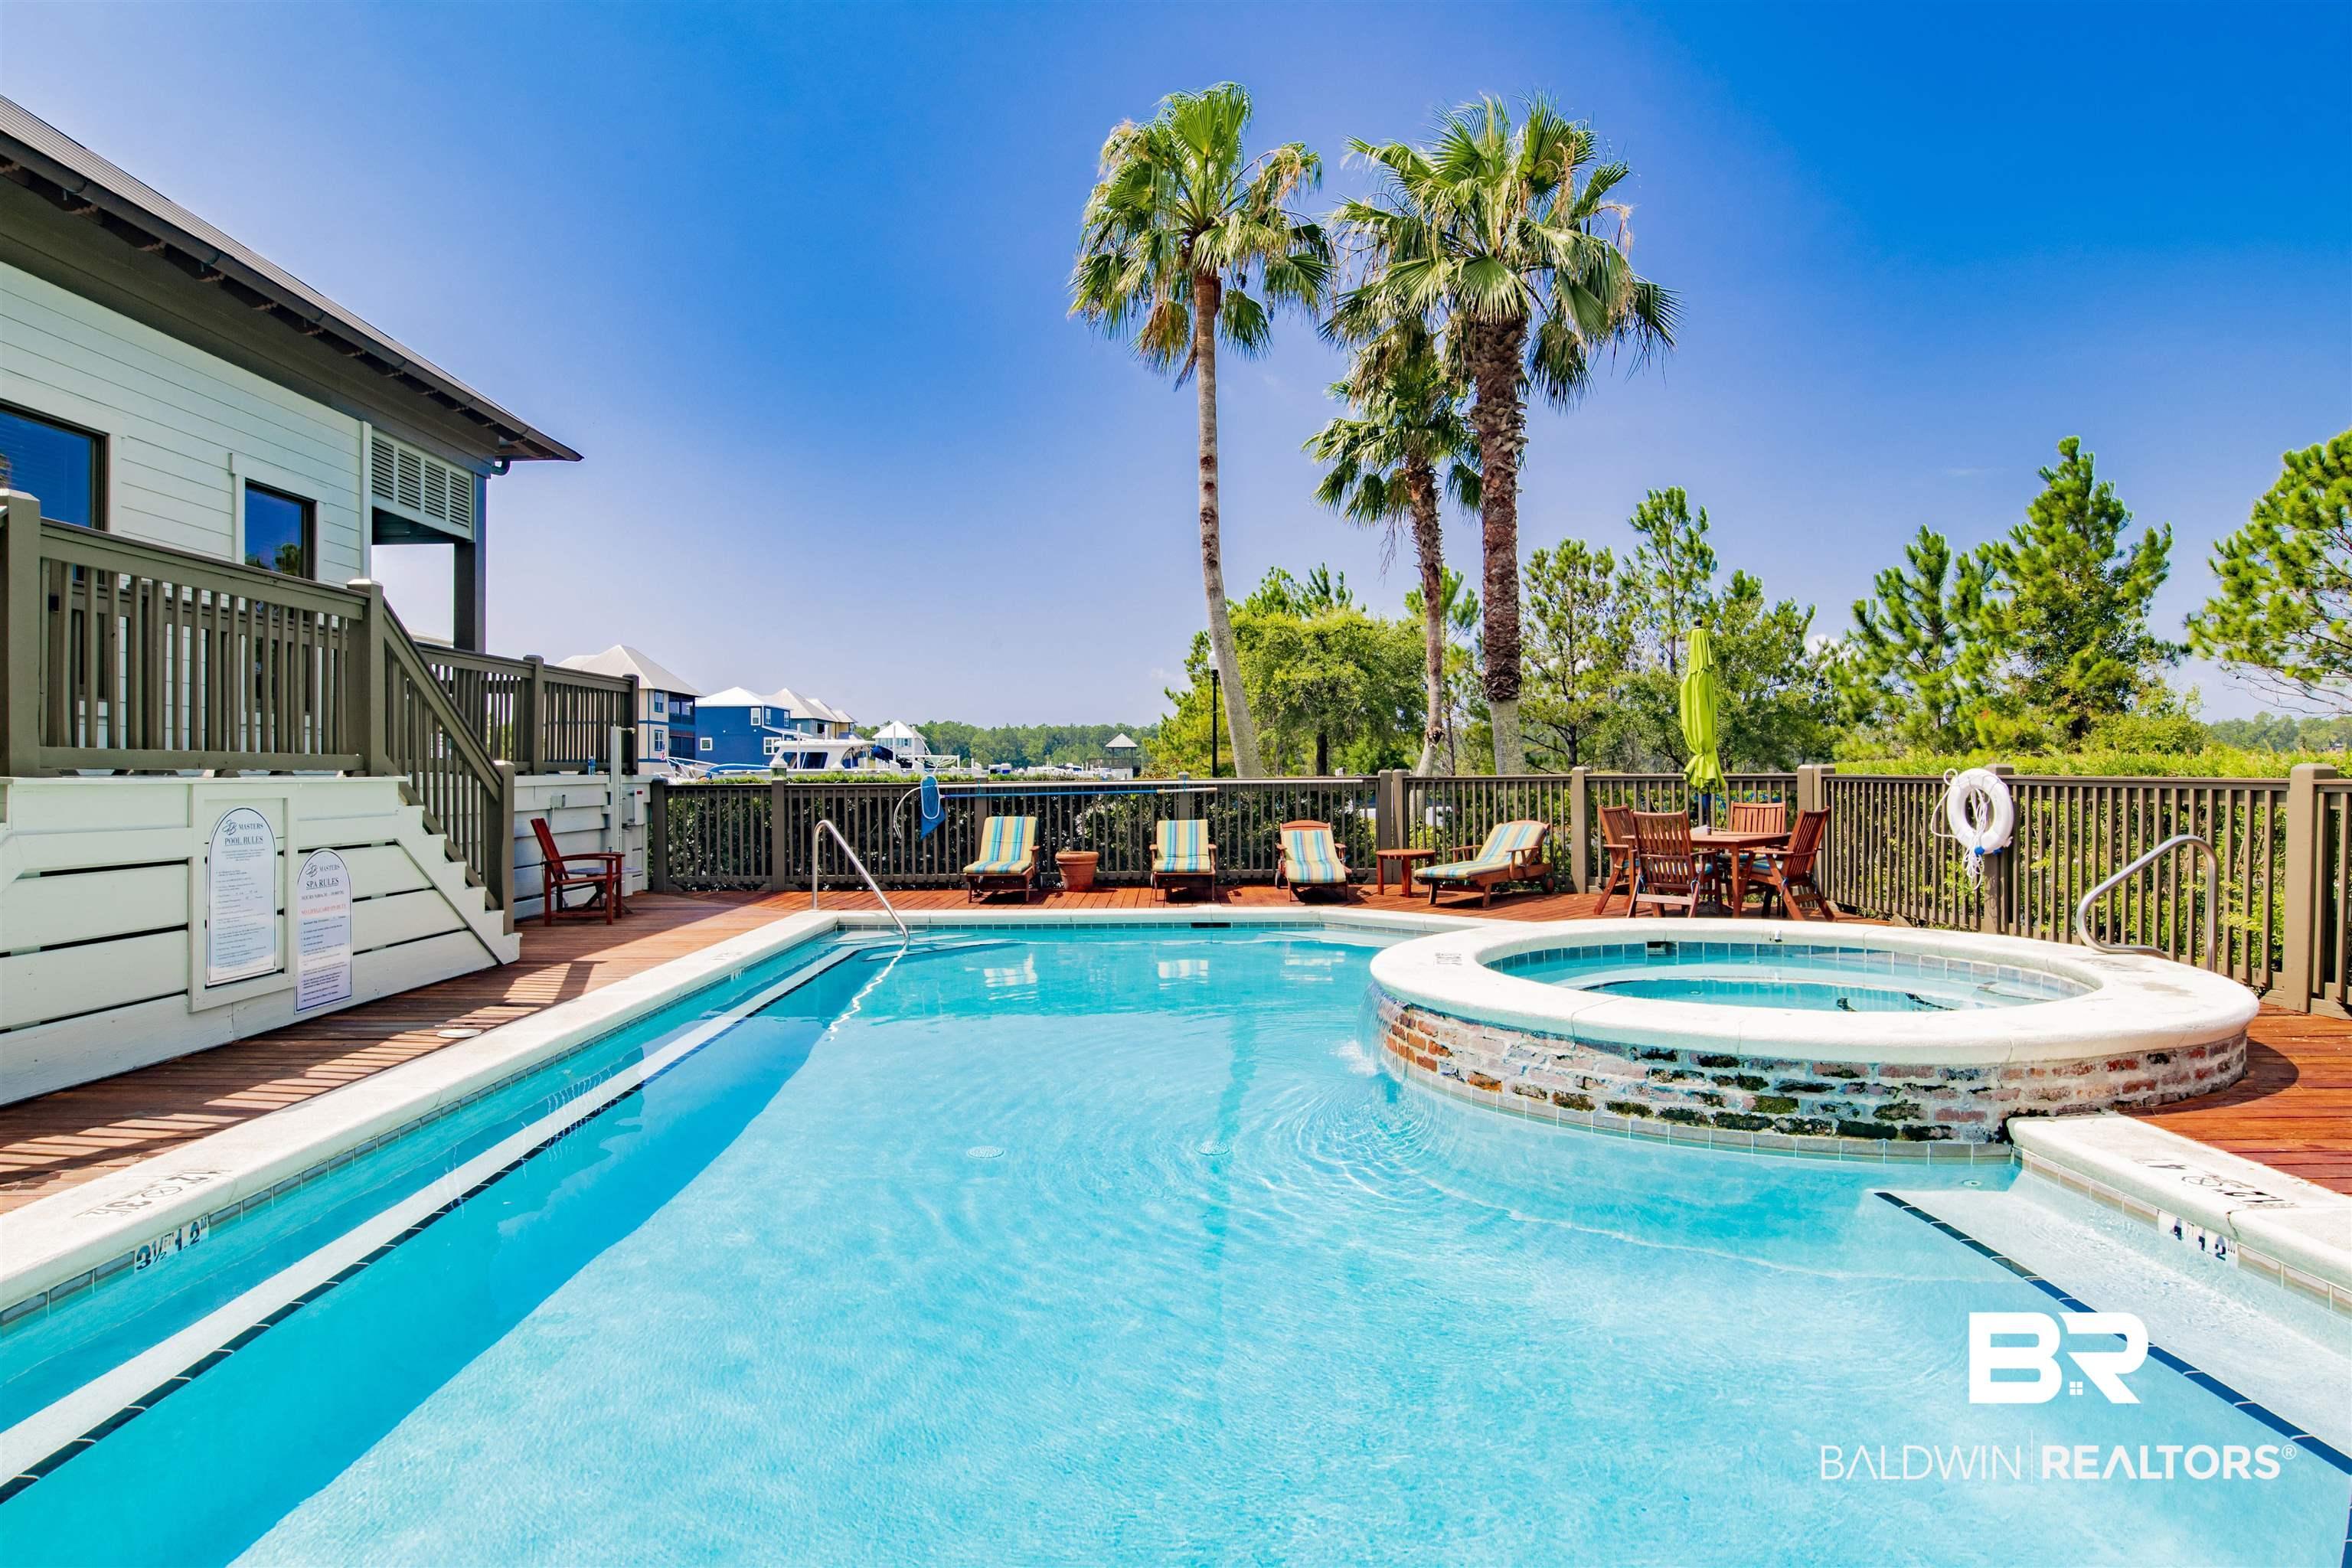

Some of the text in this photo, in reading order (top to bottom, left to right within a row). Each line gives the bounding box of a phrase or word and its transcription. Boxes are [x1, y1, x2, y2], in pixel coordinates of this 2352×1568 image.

[224, 835, 263, 846] POOL RULES
[318, 864, 341, 872] MASTERS
[305, 877, 339, 889] SPA RULES
[2169, 1217, 2183, 1241] 4
